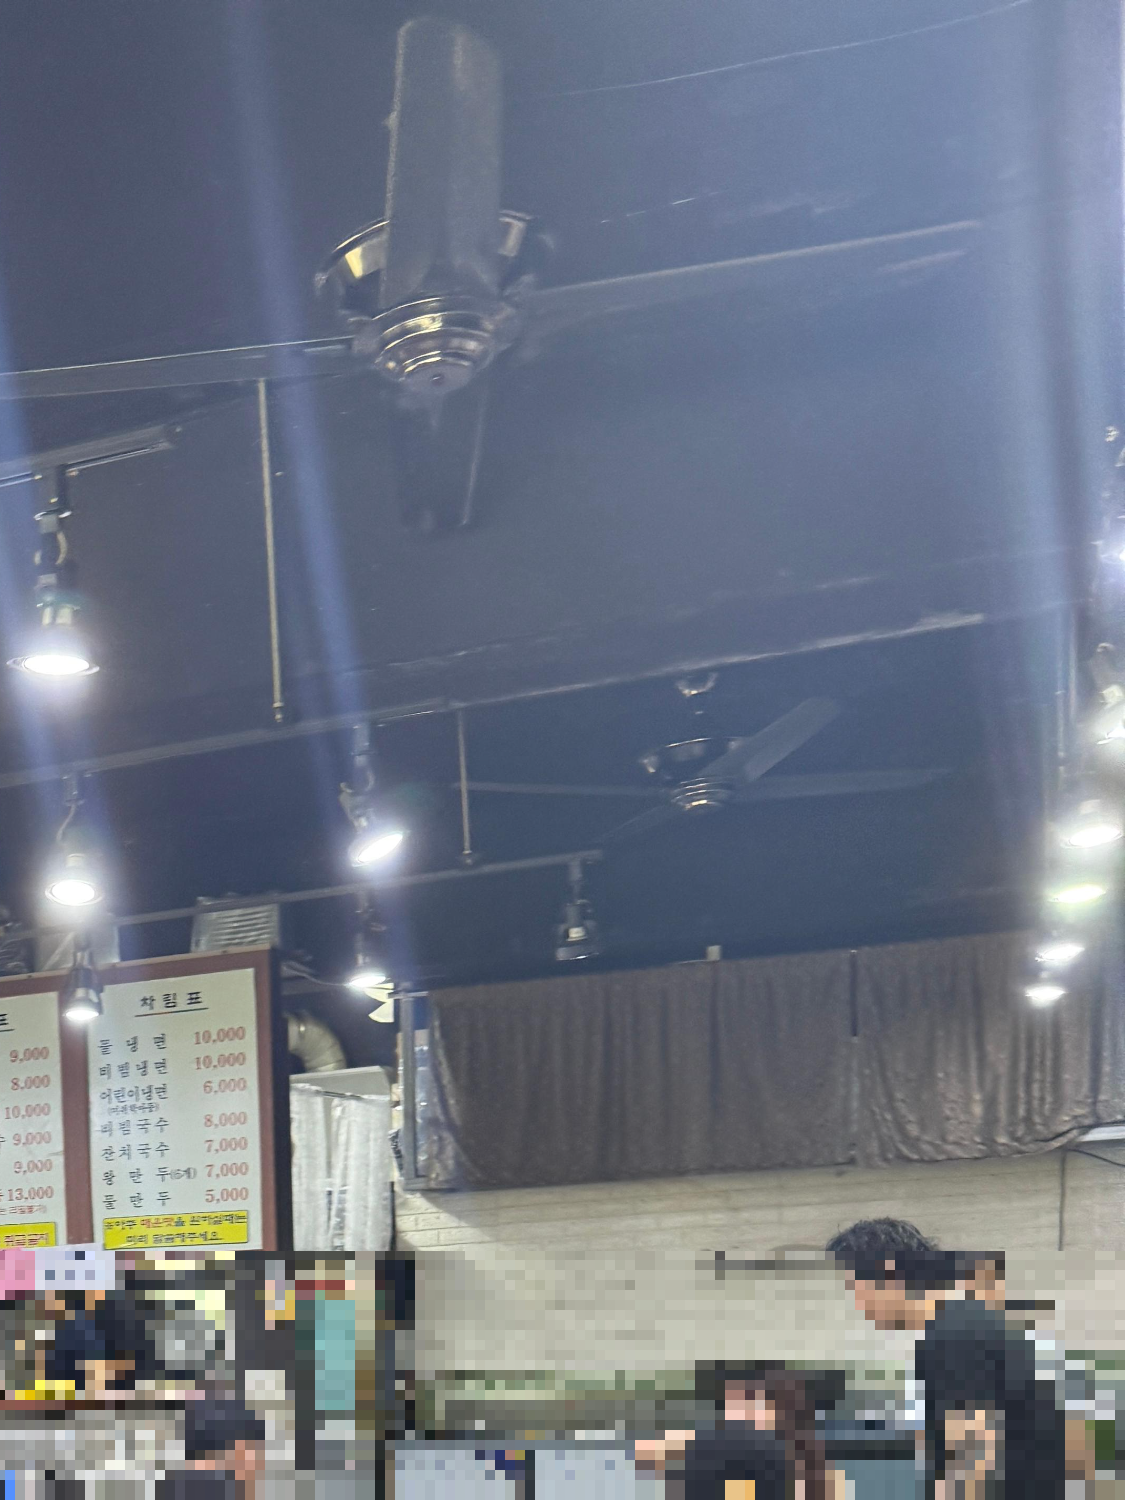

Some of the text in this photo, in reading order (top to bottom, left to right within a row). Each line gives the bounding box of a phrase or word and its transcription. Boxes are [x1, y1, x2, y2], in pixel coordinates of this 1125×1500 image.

[140, 991, 203, 1011] 차림표
[194, 1026, 246, 1045] 10,000
[9, 1046, 50, 1063] 9,000
[194, 1052, 246, 1071] 10,000
[203, 1077, 247, 1095] 6,000
[5, 1103, 51, 1120] 10,000
[204, 1111, 248, 1129] 8,000
[13, 1131, 52, 1146] 9,000
[204, 1136, 248, 1154] 7,000
[205, 1162, 249, 1179] 7,000
[205, 1187, 249, 1204] 5,000
